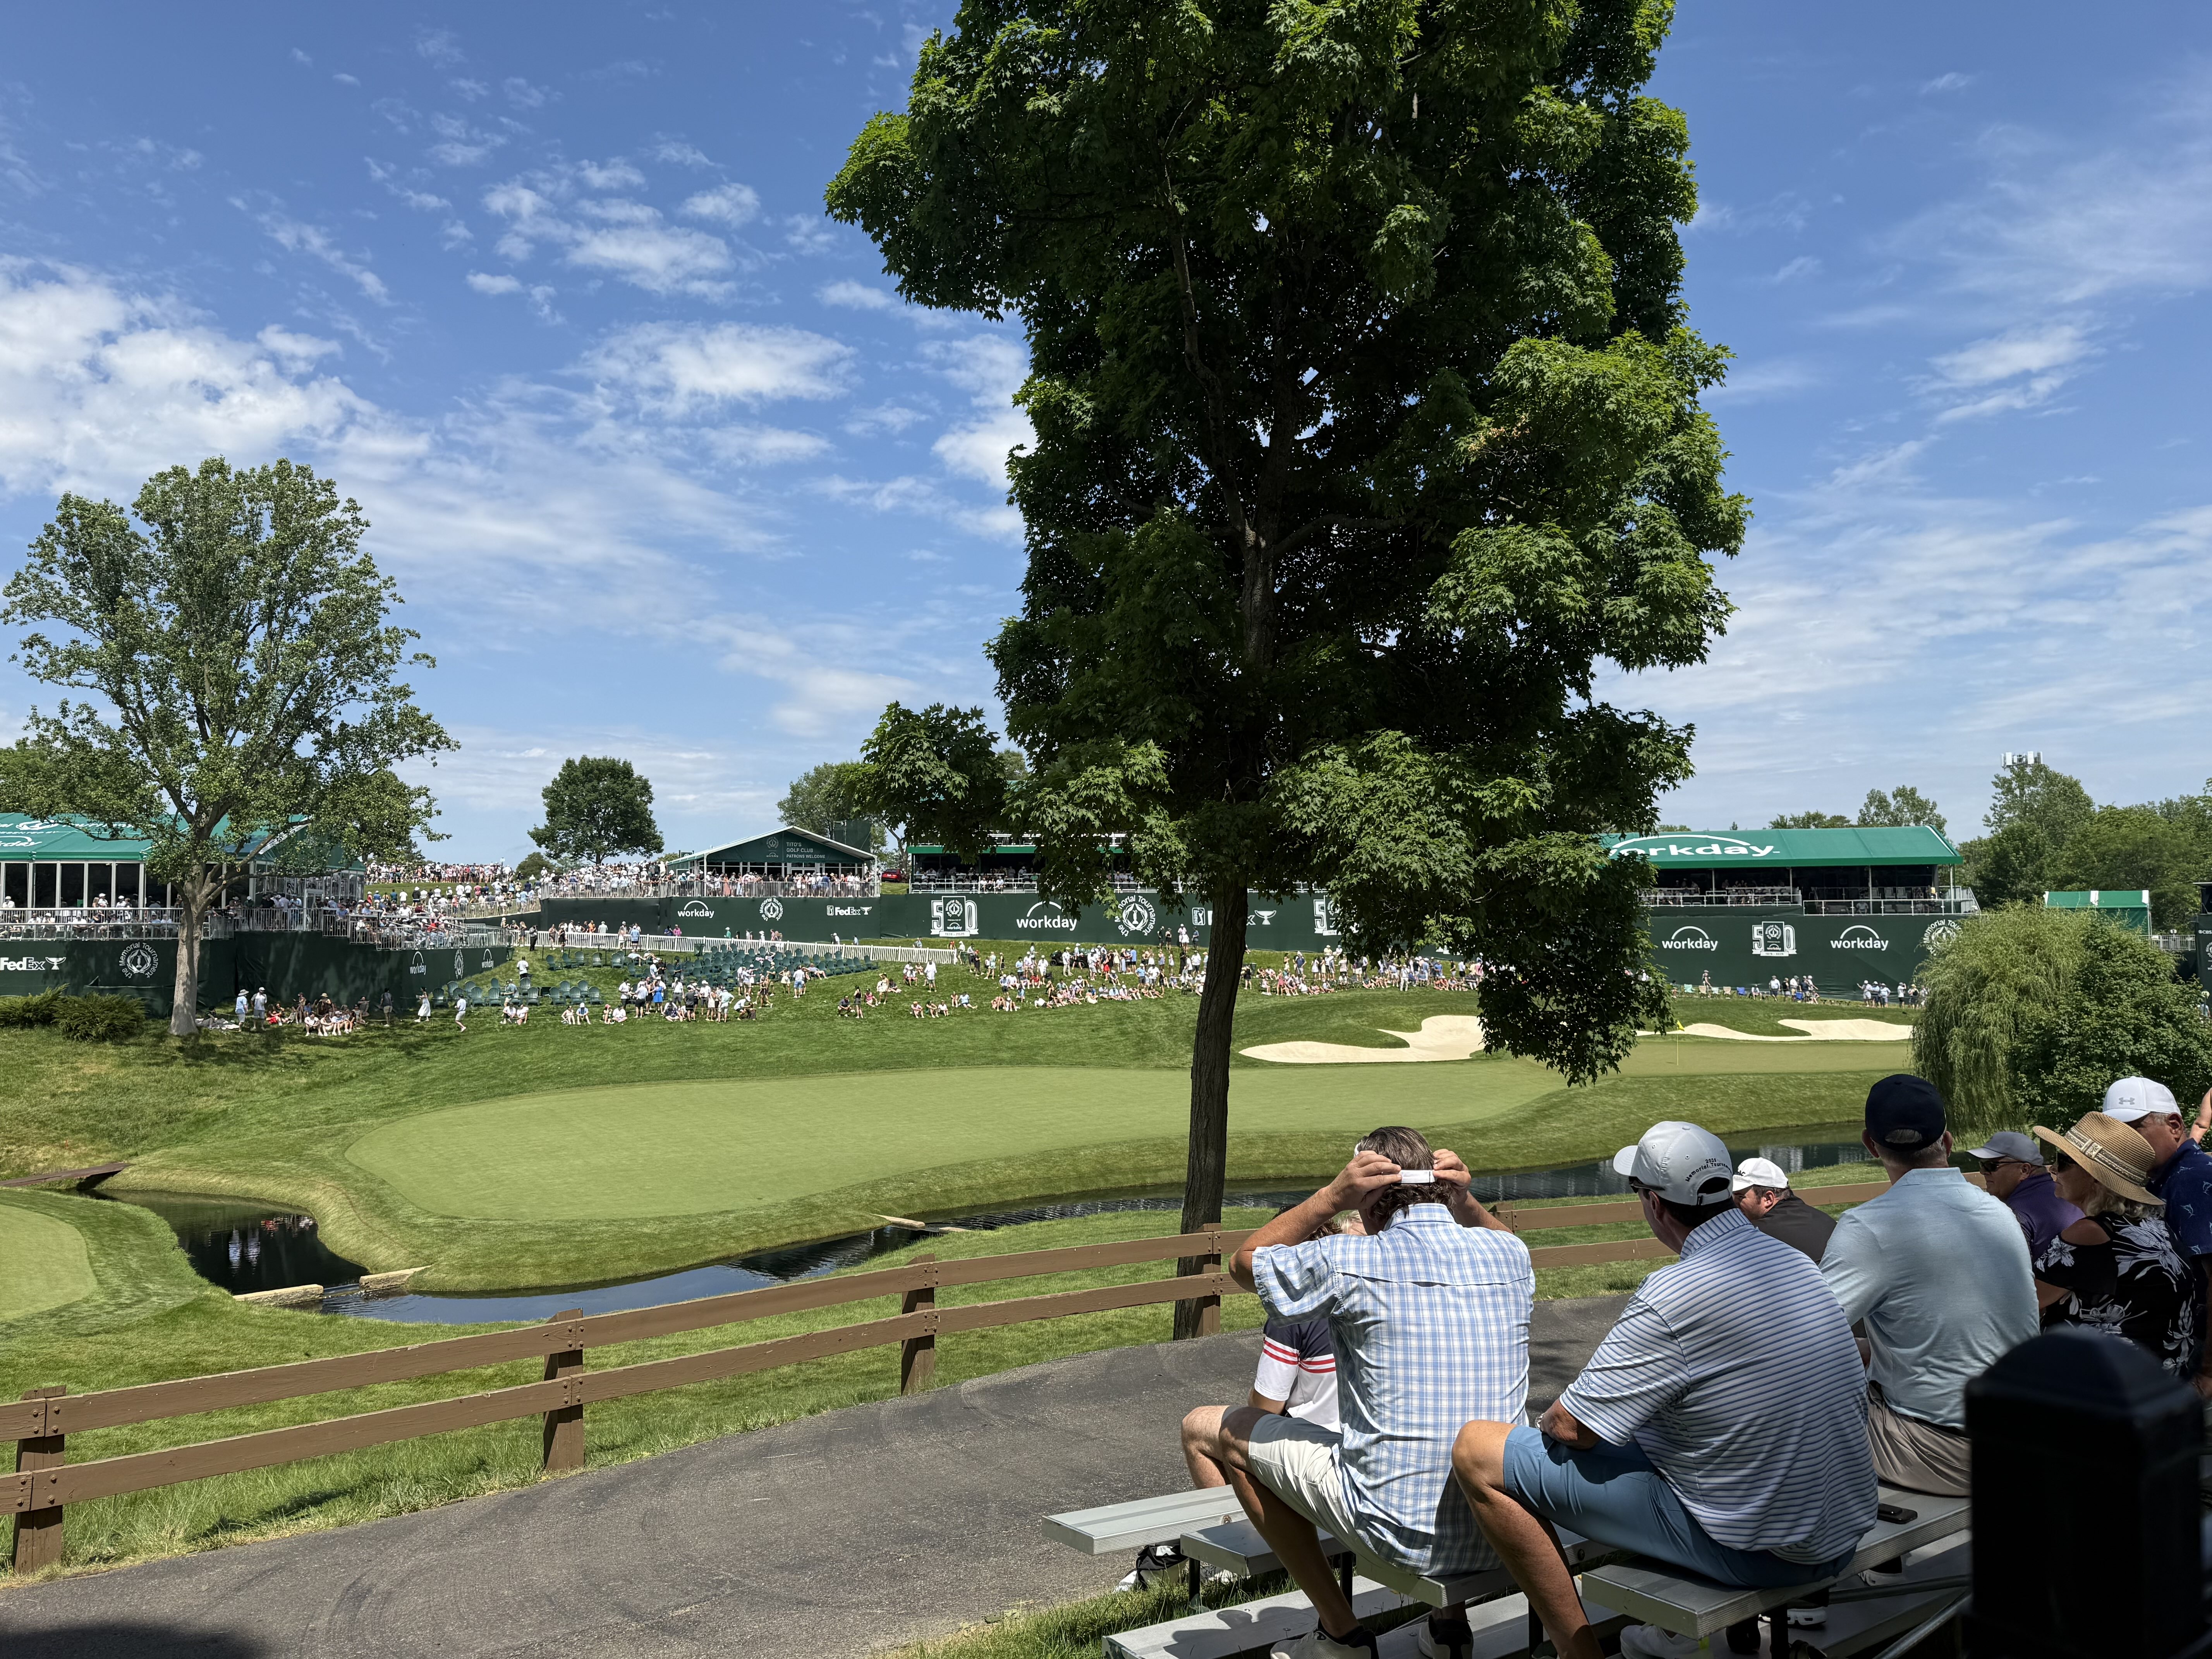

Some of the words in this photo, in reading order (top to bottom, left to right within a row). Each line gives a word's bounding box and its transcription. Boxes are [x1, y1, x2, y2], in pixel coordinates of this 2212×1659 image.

[677, 908, 714, 918] workday
[835, 907, 861, 915] FedEx
[1118, 924, 1129, 937] the
[1138, 895, 1156, 936] Tournament
[1016, 915, 1077, 931] workday
[1923, 919, 1945, 943] Memorial
[1662, 938, 1718, 951] workday
[1830, 937, 1889, 951] workday
[119, 942, 140, 966] Memorial
[143, 943, 158, 978] Tournament
[0, 957, 46, 970] FedEx
[410, 963, 426, 975] workday
[122, 968, 132, 979] the
[1685, 1164, 1709, 1182] Memorial
